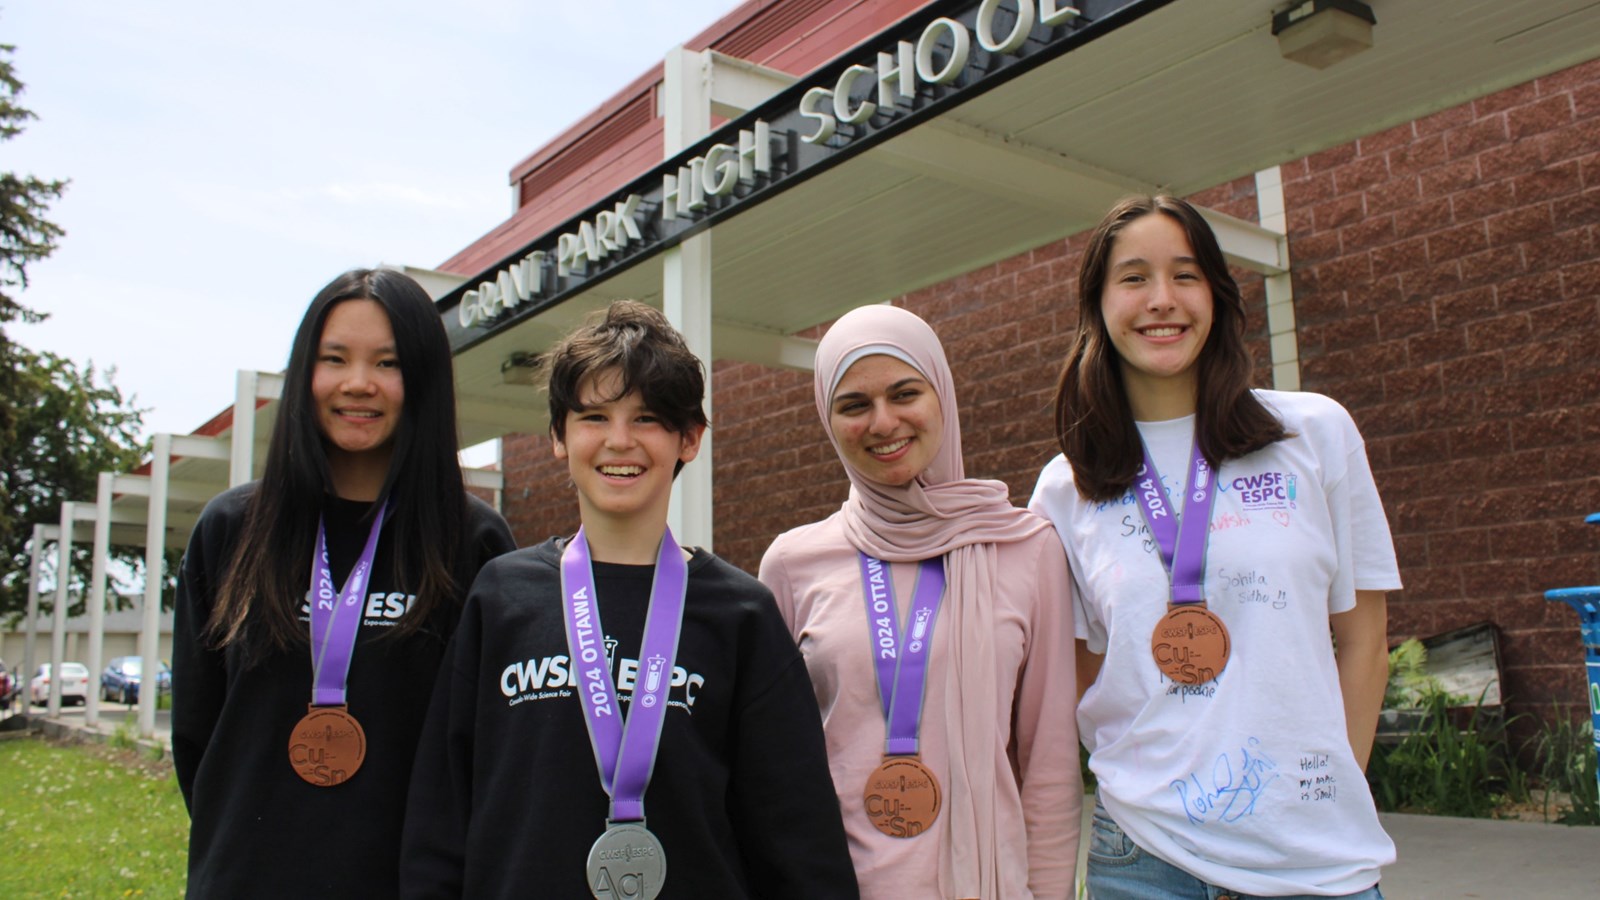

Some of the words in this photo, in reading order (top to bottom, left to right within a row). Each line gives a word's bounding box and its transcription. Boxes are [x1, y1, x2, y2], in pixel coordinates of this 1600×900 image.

[459, 250, 546, 328] GRANT
[558, 194, 642, 277] PARK
[663, 119, 770, 220] HIGH
[1232, 472, 1282, 491] CWSF
[1140, 478, 1167, 519] 2024
[1241, 486, 1286, 503] ESPC
[318, 568, 333, 611] 2024
[866, 558, 889, 613] OTTAW
[573, 586, 598, 663] OTTAWA
[876, 617, 897, 659] 2024
[1180, 663, 1215, 685] Sn
[586, 668, 612, 717] 2024
[1300, 754, 1328, 770] Hello!
[1300, 779, 1312, 789] my
[1301, 792, 1309, 800] is
[889, 816, 922, 838] Sn
[599, 849, 625, 860] CWSF
[632, 847, 655, 857] ESPC
